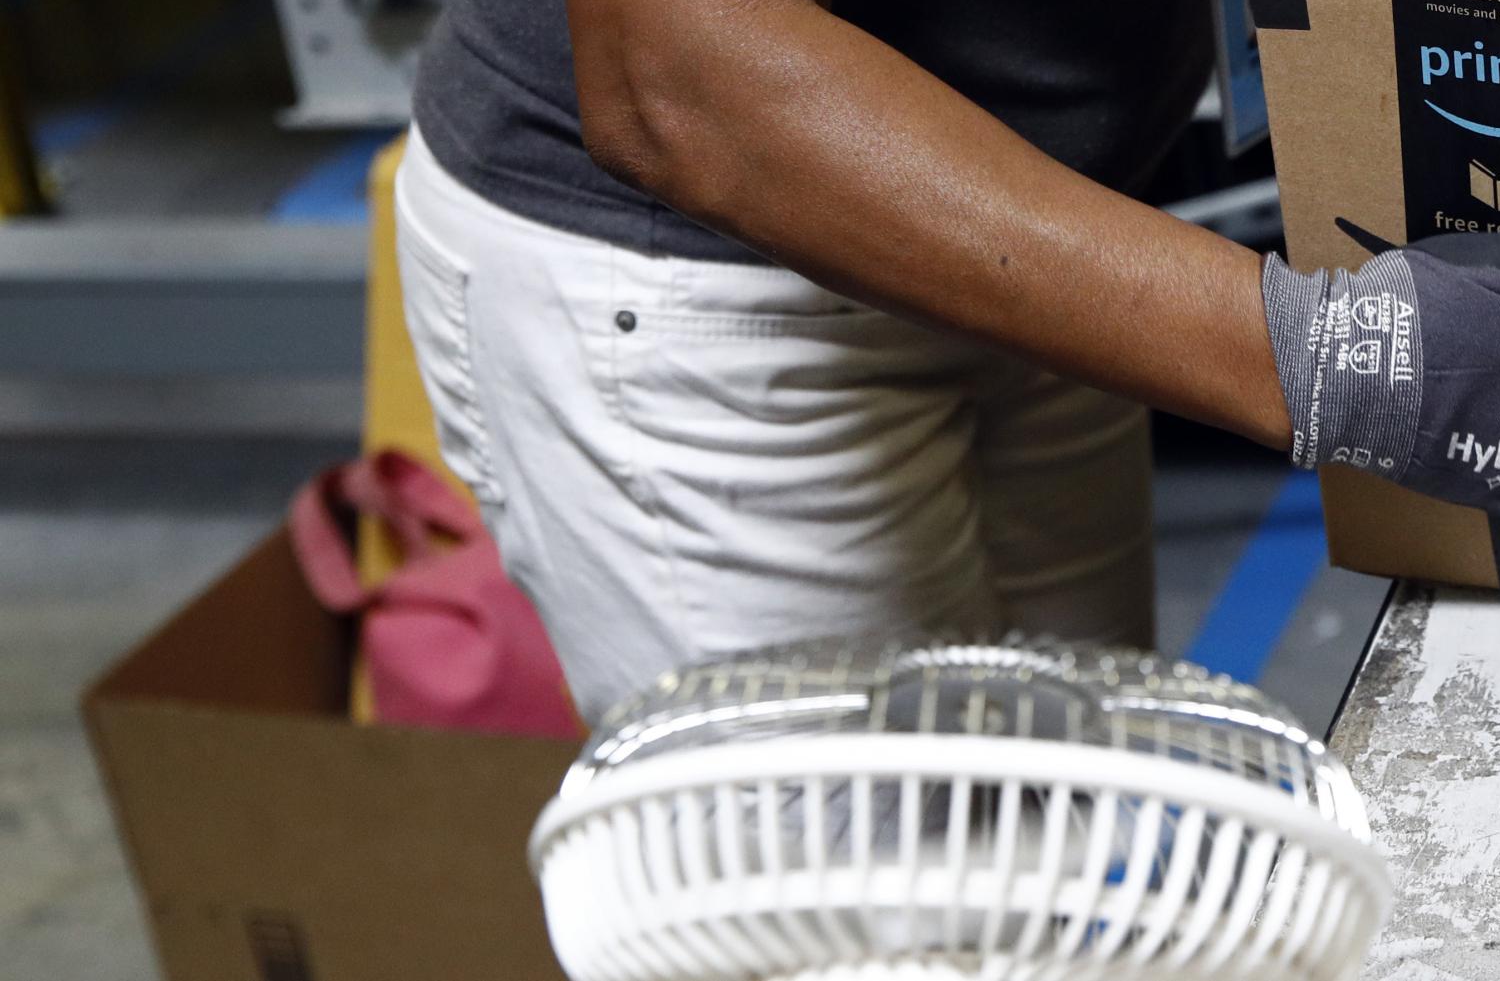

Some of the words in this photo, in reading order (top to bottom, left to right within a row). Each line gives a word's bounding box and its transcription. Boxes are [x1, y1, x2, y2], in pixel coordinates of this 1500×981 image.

[1425, 0, 1470, 17] movies
[1473, 7, 1497, 20] and
[1434, 210, 1479, 233] free
[1394, 300, 1416, 382] Ansell
